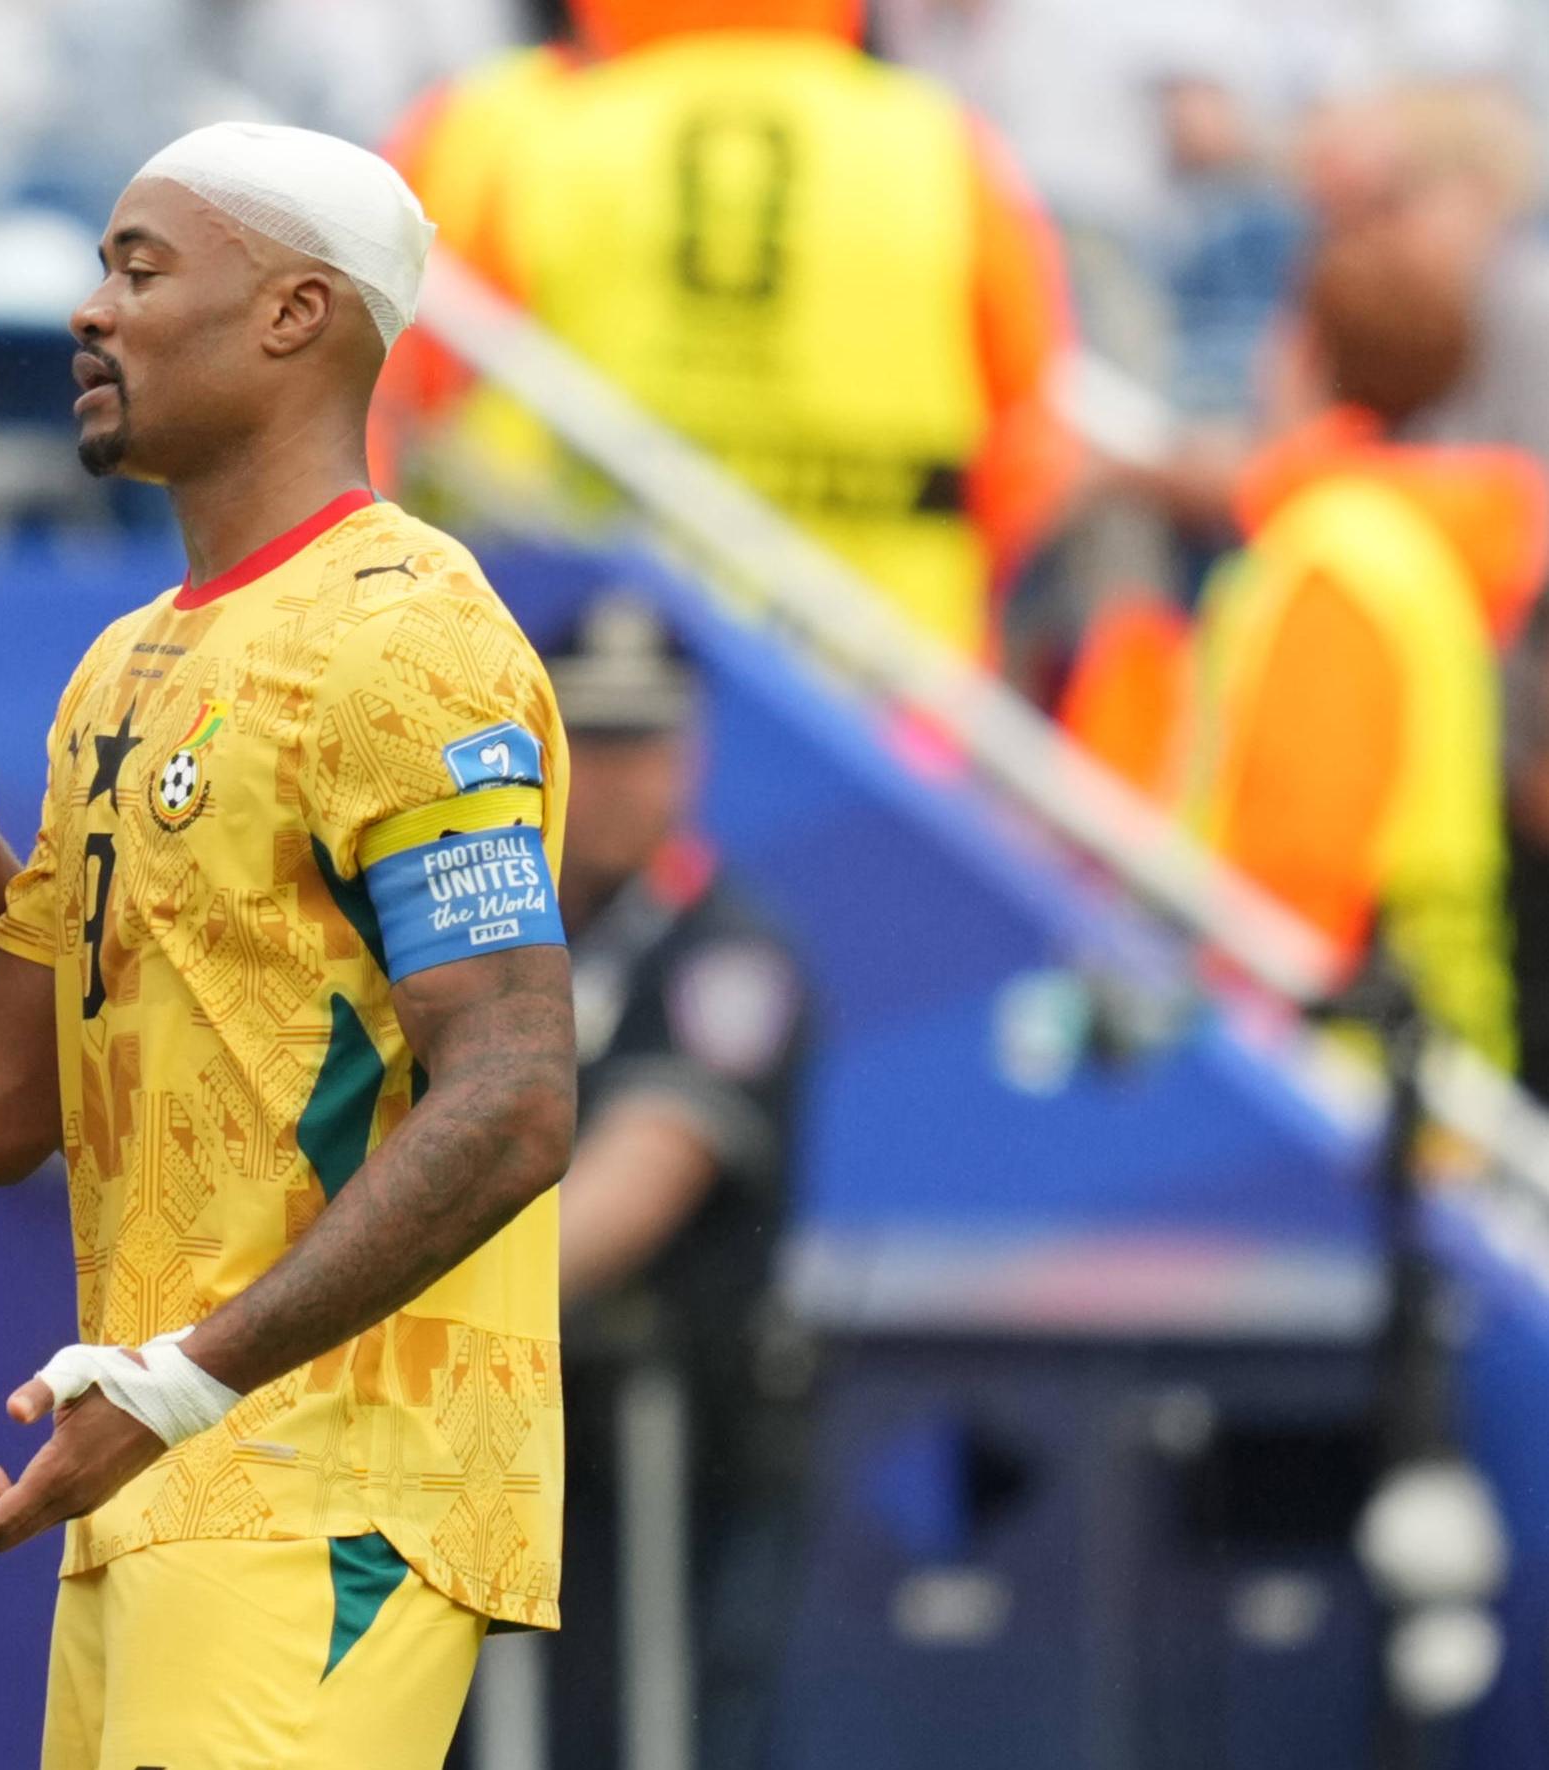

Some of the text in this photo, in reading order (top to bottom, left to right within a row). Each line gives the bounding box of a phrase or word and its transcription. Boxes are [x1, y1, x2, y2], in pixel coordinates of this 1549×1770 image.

[423, 836, 532, 875] FOOTBALL
[427, 858, 539, 902] UNITES
[82, 833, 116, 1020] 9
[428, 887, 546, 931] the World
[473, 921, 516, 942] FIFA
